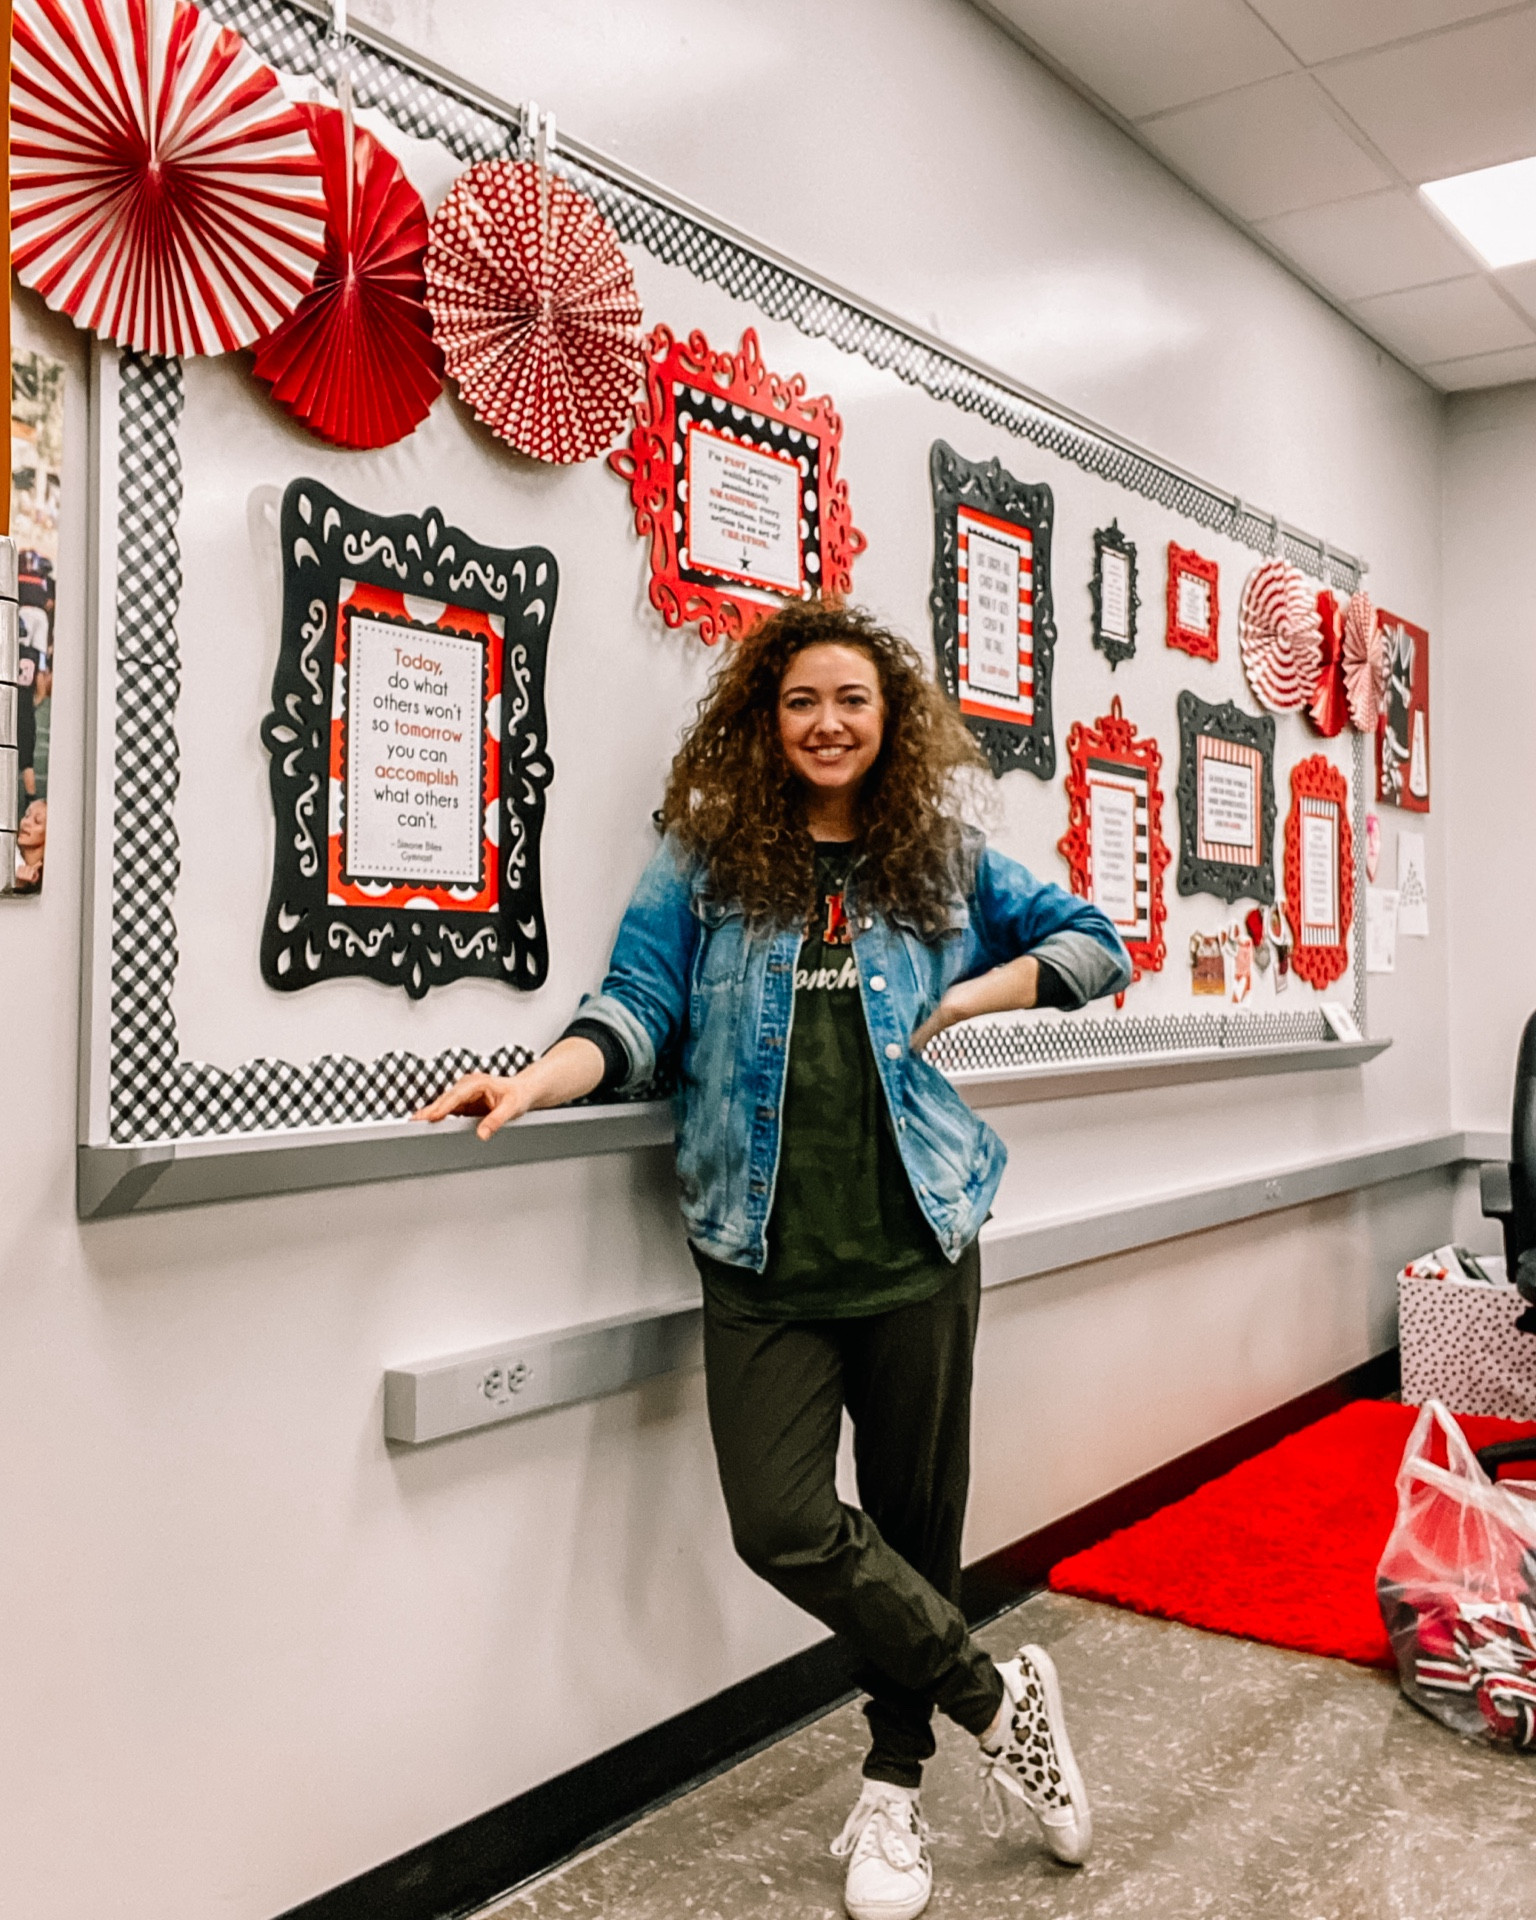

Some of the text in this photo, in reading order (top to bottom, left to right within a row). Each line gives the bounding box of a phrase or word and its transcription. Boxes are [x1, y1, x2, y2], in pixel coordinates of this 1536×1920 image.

[394, 648, 443, 675] Today,
[388, 672, 448, 697] do what
[373, 695, 461, 721] others won't
[372, 718, 462, 743] so tomorrow
[387, 743, 447, 763] you can
[375, 764, 459, 787] accomplish
[374, 786, 459, 809] what others
[398, 812, 437, 829] can't.
